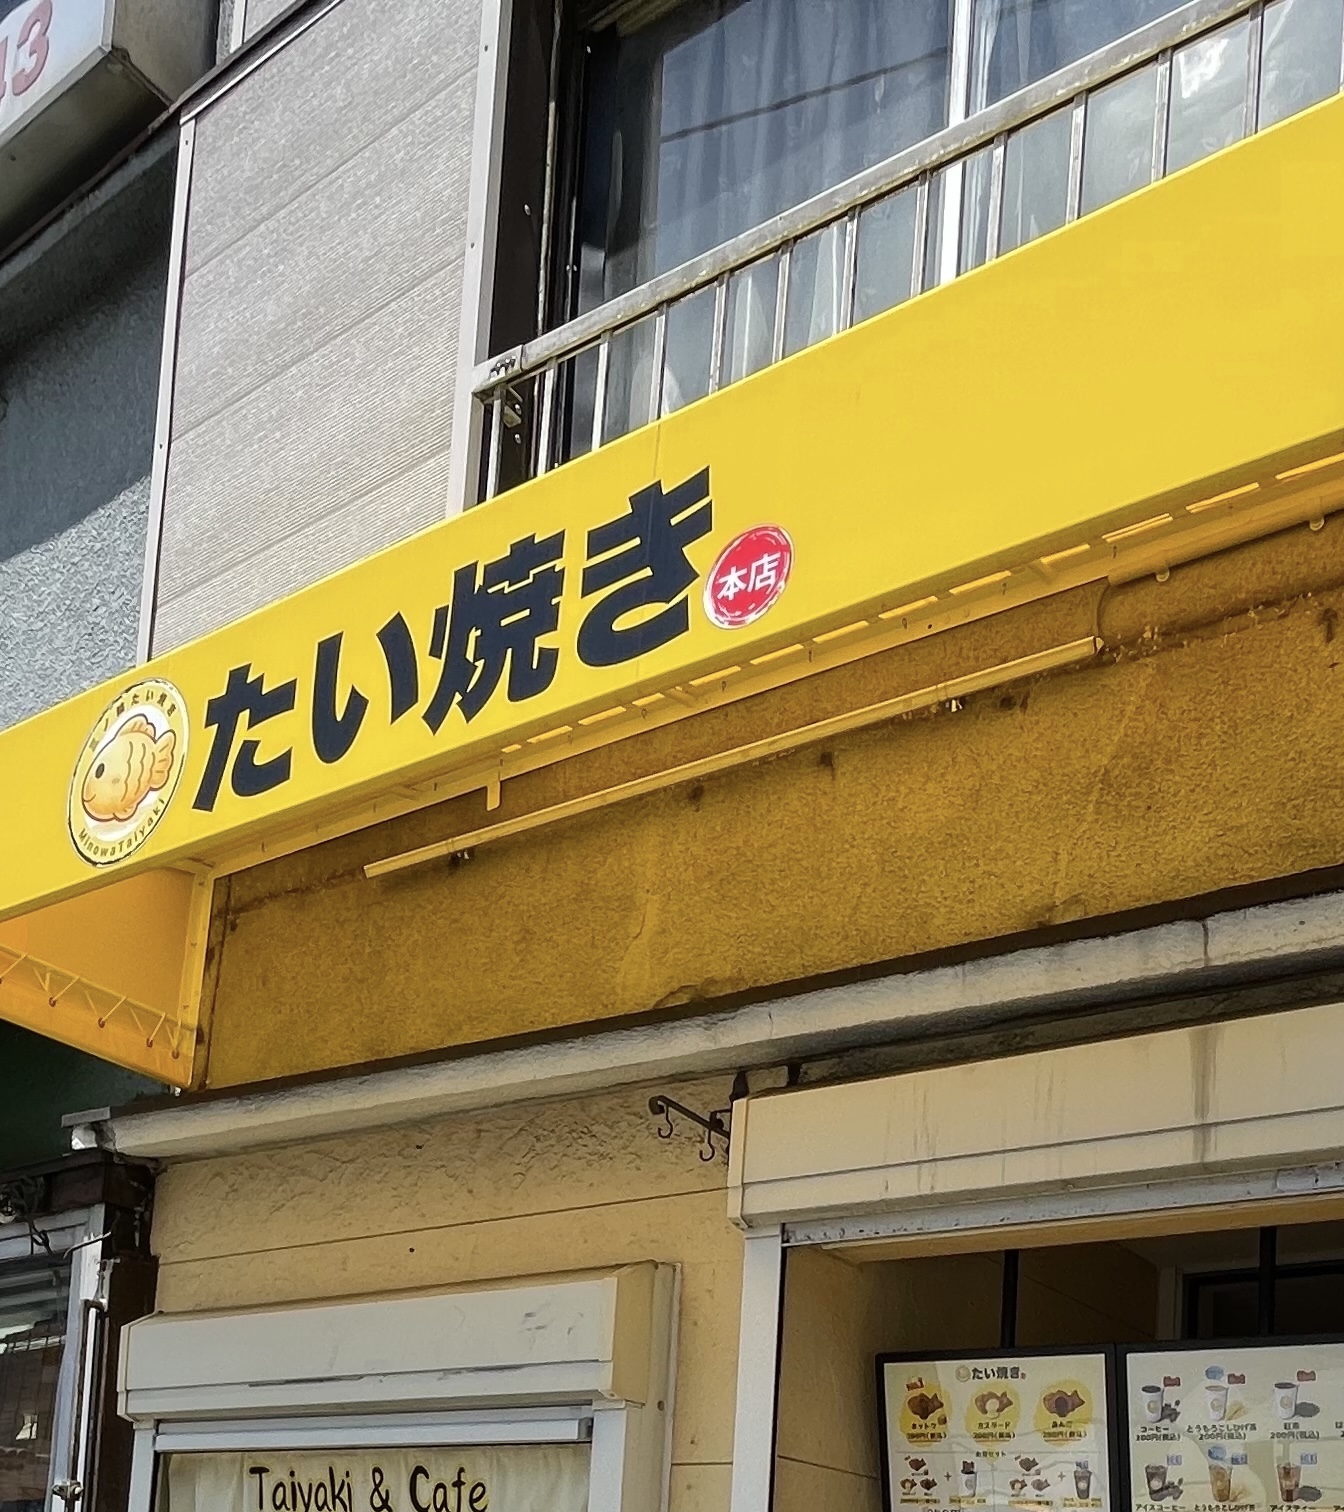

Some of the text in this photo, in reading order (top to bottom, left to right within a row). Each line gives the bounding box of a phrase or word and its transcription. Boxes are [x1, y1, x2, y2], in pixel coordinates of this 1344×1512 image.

[191, 464, 714, 812] たい焼き
[717, 552, 781, 602] 本店
